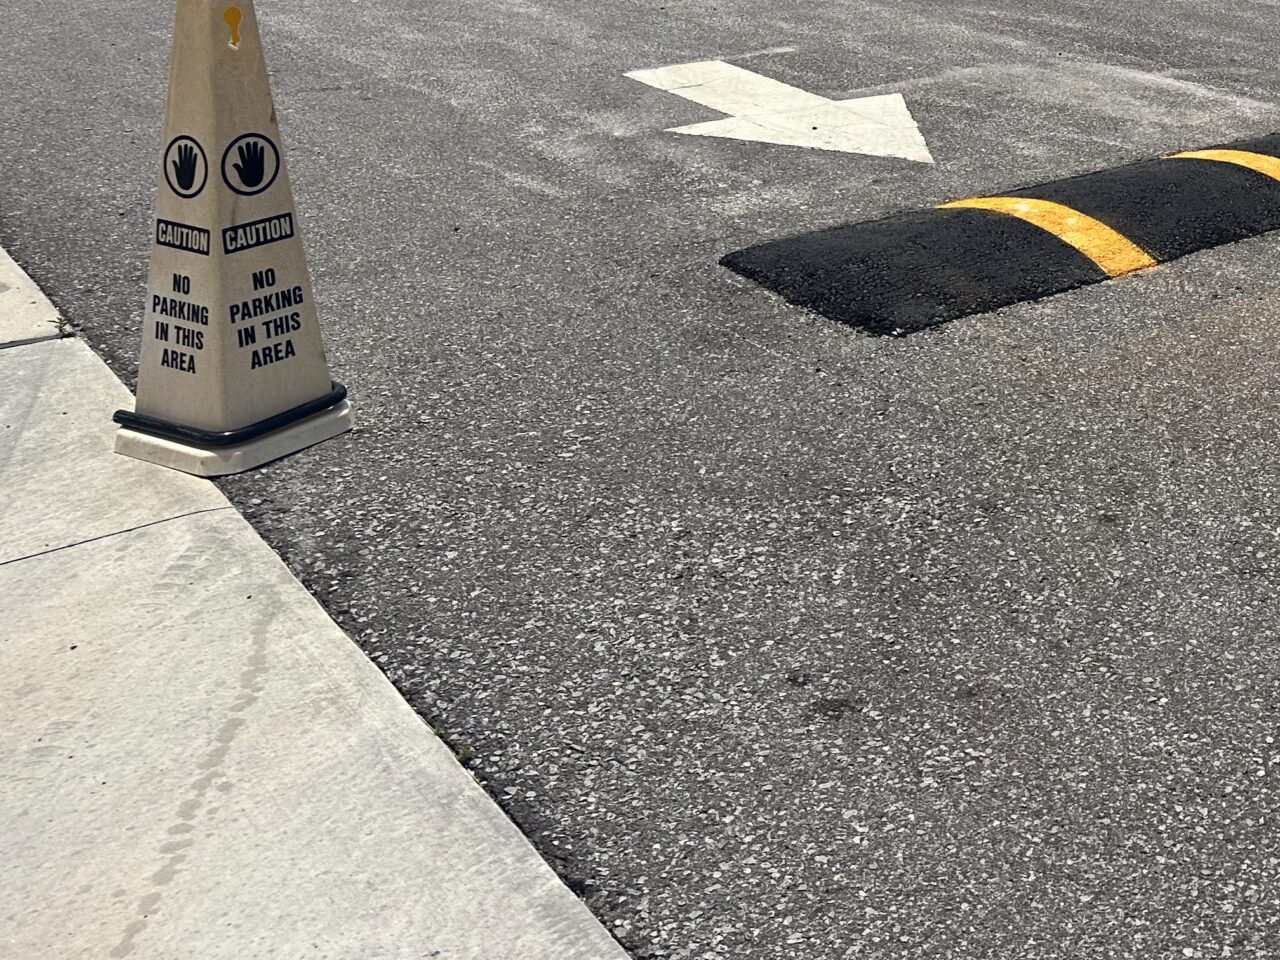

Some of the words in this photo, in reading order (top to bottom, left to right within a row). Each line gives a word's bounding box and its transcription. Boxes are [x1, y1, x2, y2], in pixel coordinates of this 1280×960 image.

[158, 222, 208, 252] CAUTION
[225, 216, 292, 251] CAUTION
[173, 273, 191, 295] NO
[252, 268, 276, 291] NO
[152, 294, 209, 326] PARKING
[229, 286, 304, 324] PARKING
[155, 321, 169, 342] IN
[174, 325, 204, 350] THIS
[237, 325, 256, 348] IN
[262, 312, 301, 339] THIS
[161, 348, 196, 374] AREA
[251, 340, 296, 370] AREA
